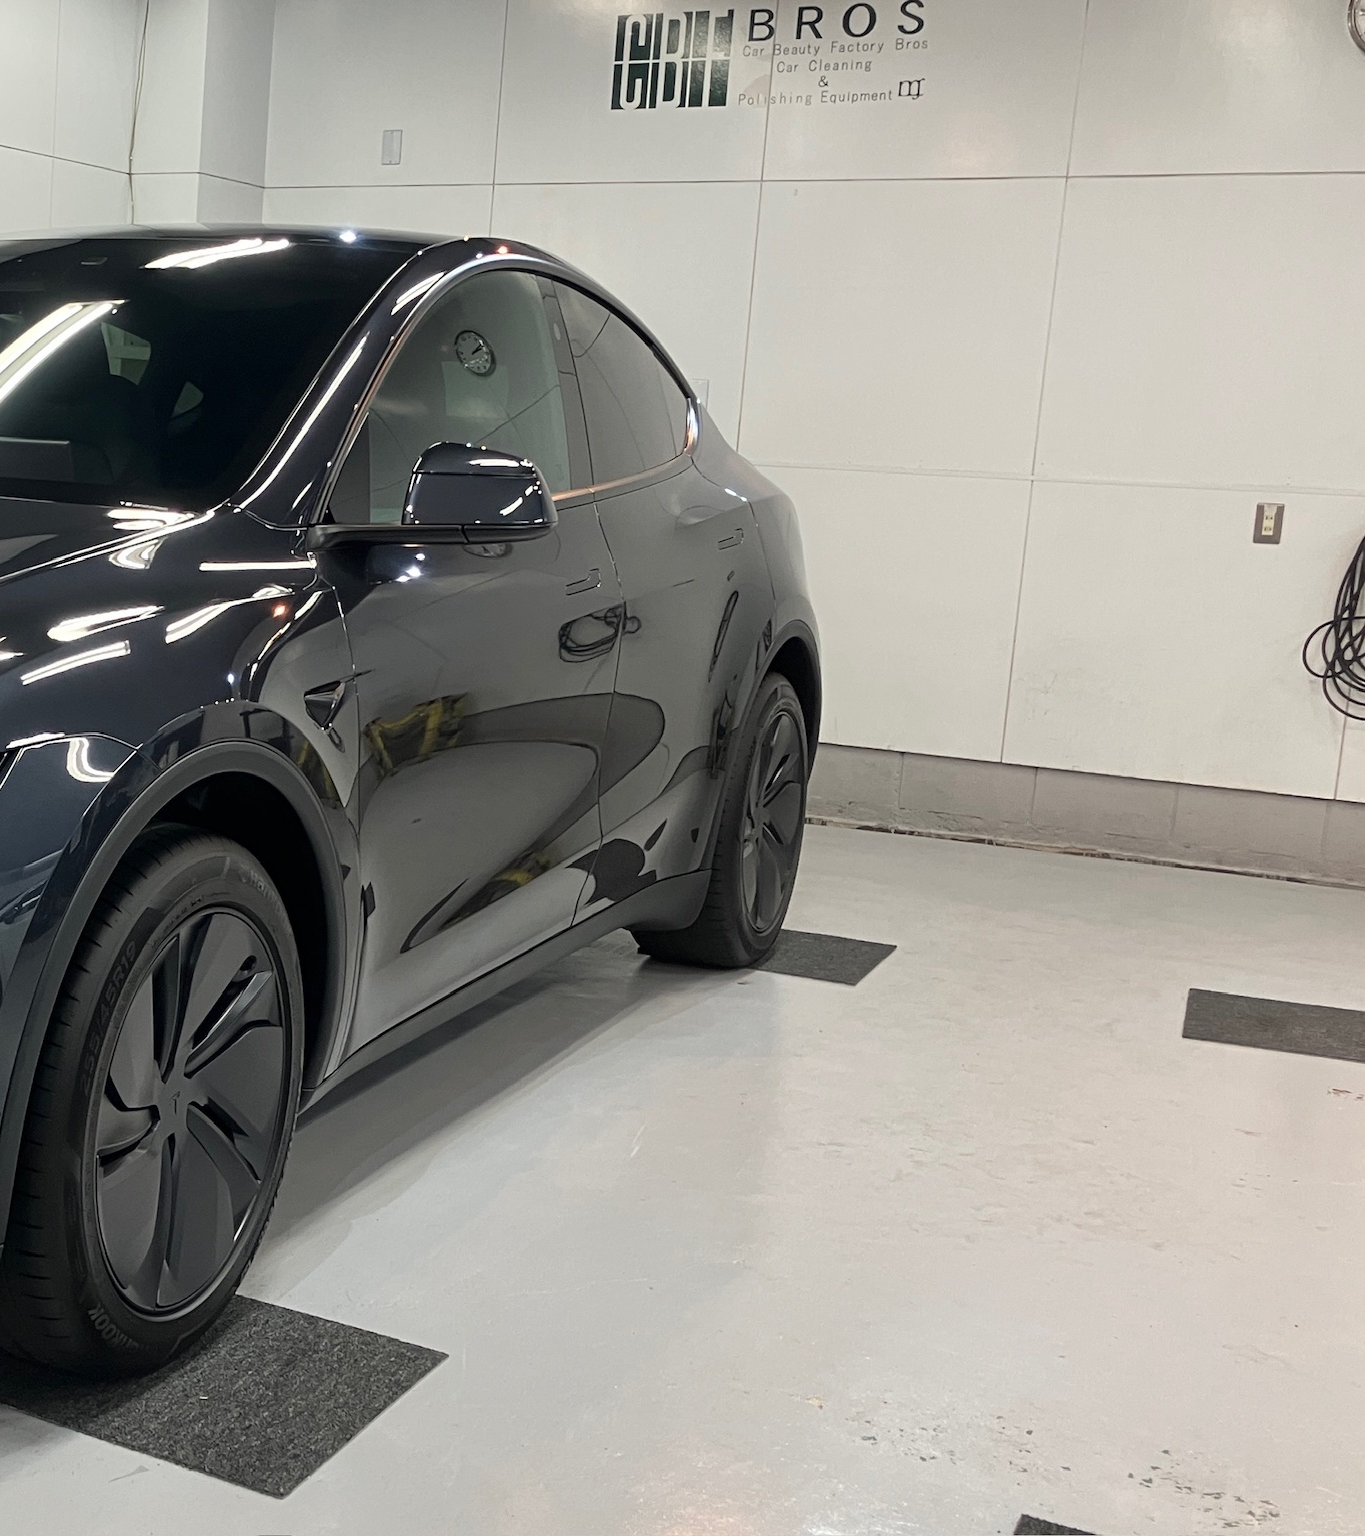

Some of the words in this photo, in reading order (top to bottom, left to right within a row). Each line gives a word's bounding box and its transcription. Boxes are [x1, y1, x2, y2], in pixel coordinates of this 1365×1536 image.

[748, 0, 925, 42] BROS
[742, 45, 765, 57] Car
[773, 43, 820, 56] Beauty
[830, 40, 884, 53] Factory
[895, 38, 928, 50] Bros
[776, 61, 798, 73] Car
[808, 59, 872, 72] Cleaning
[818, 75, 829, 87] &
[738, 92, 812, 106] Polishing
[820, 90, 892, 104] Equipment
[80, 939, 136, 1098] 255/45R19
